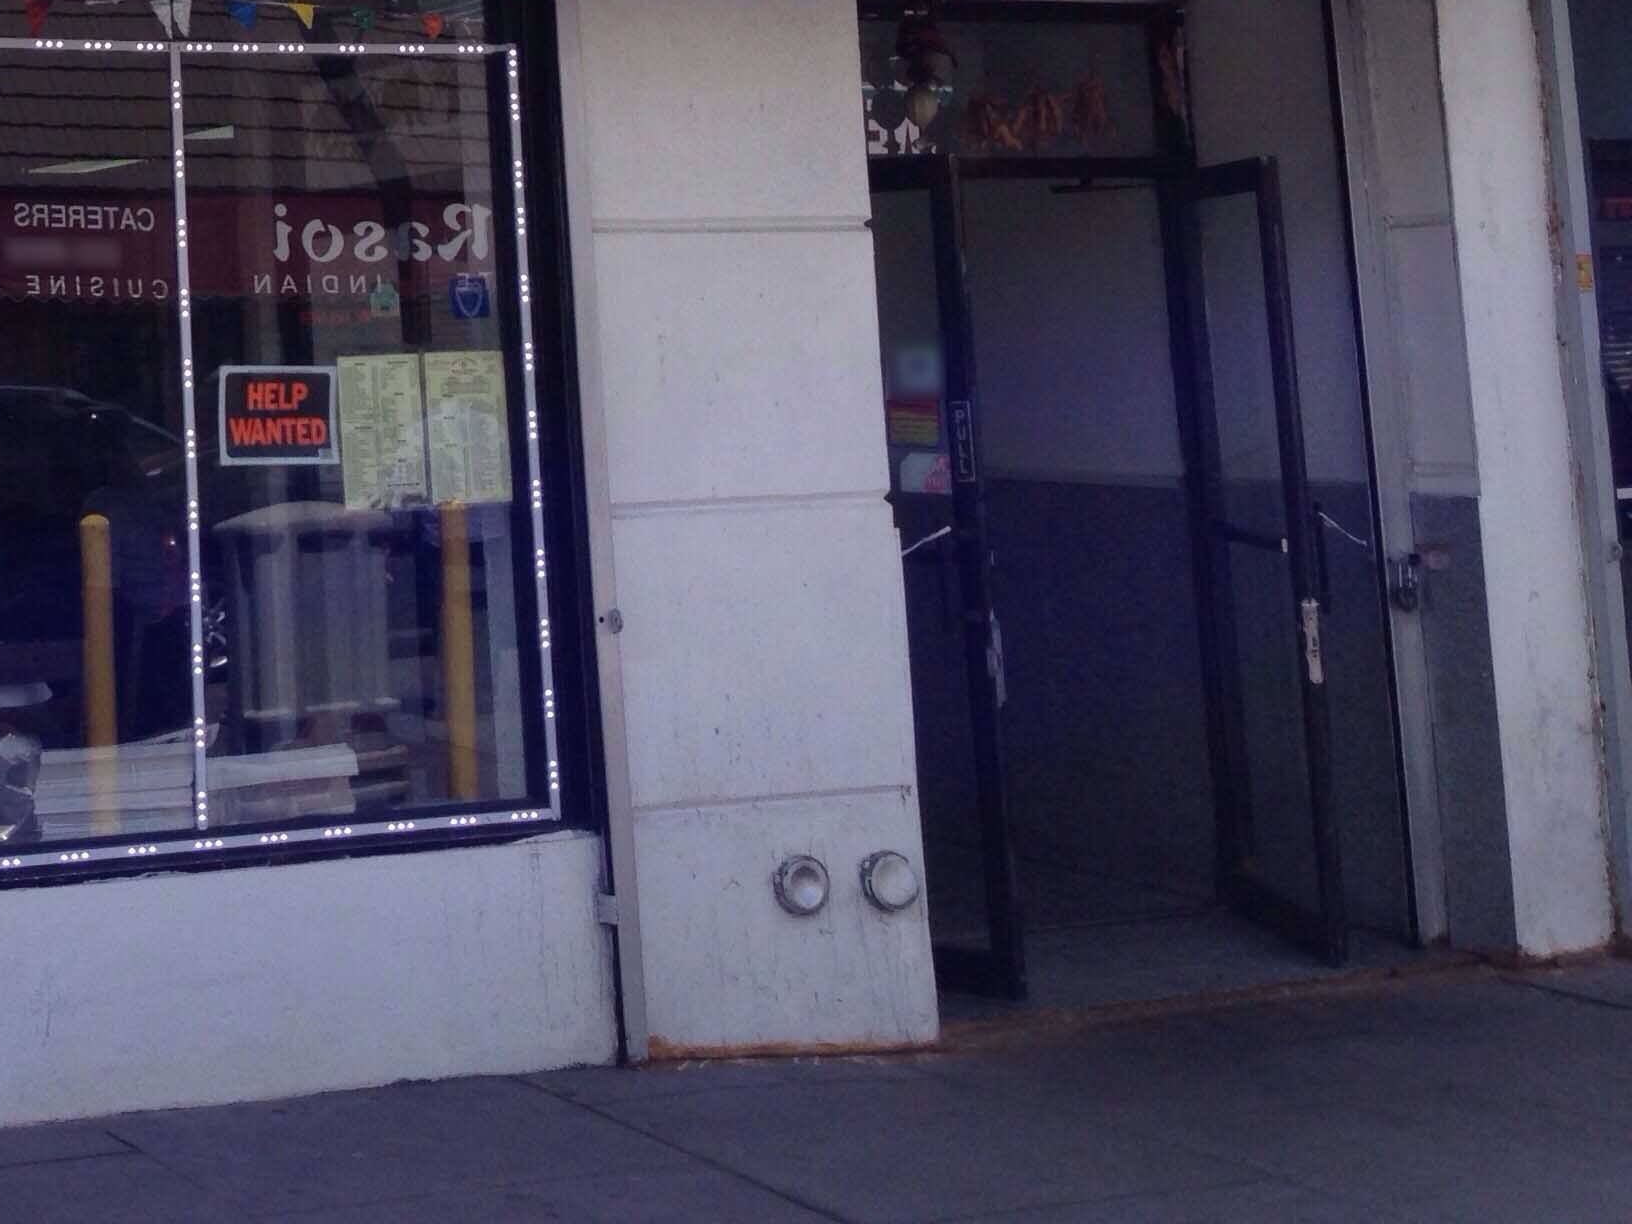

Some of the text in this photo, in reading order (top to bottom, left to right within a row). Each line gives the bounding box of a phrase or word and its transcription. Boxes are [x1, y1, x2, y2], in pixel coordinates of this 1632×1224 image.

[246, 381, 309, 411] HELP
[229, 416, 327, 447] WANTED
[952, 409, 968, 475] PULL
